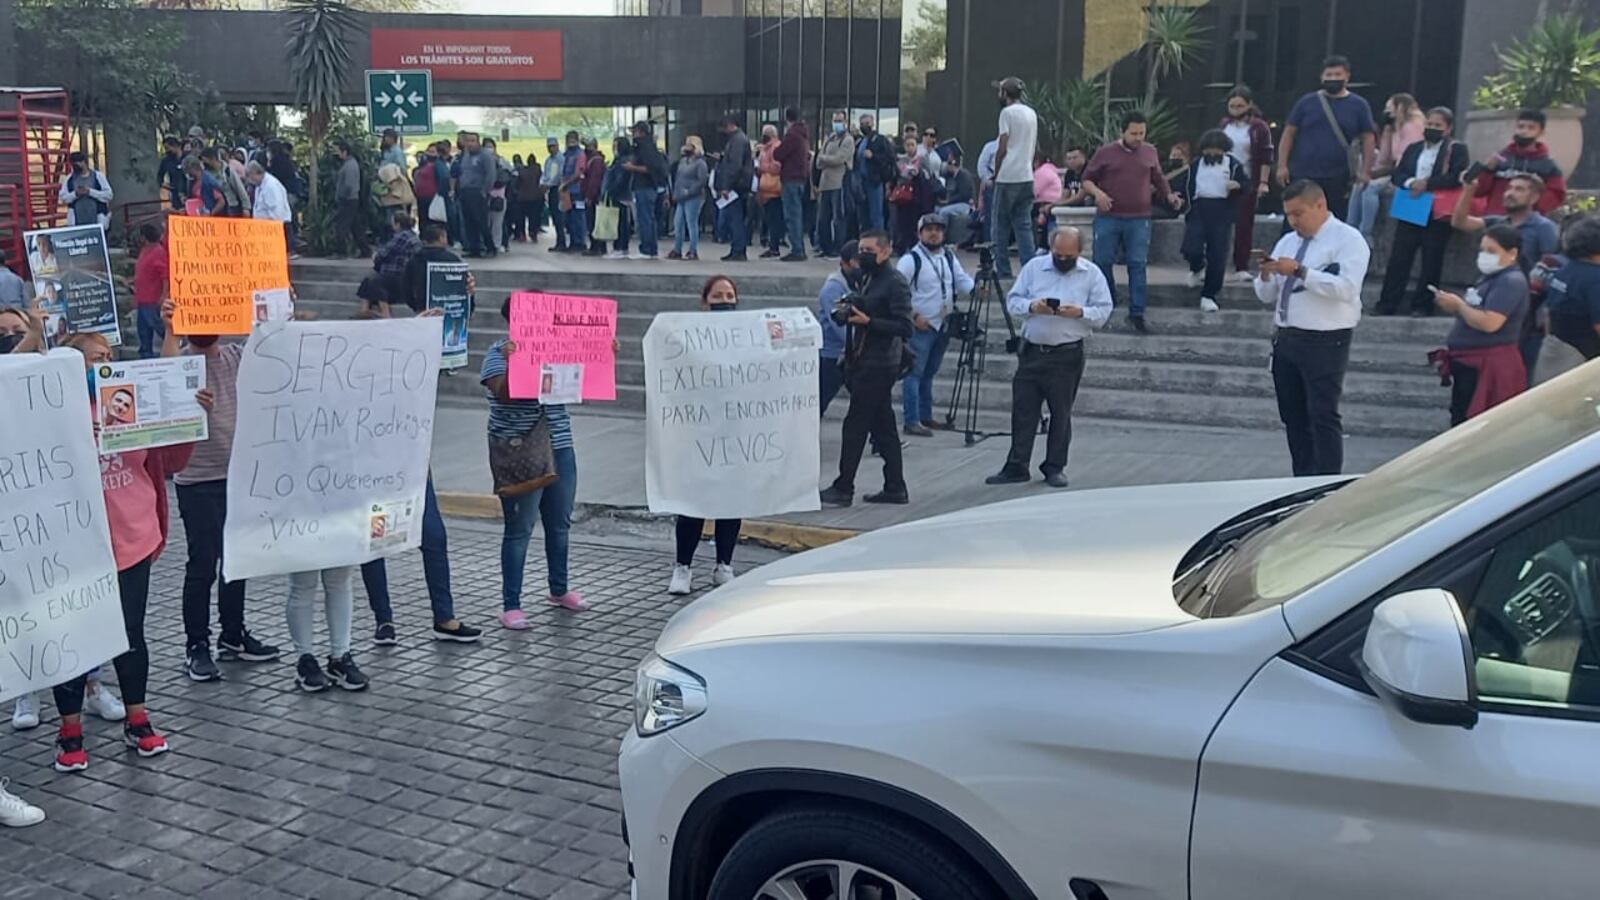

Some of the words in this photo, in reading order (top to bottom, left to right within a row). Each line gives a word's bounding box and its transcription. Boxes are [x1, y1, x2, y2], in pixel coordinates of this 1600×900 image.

[400, 56, 418, 64] LOS
[420, 54, 463, 64] TRÁMITES
[464, 56, 483, 64] SON
[485, 56, 534, 64] GRATUITOS
[423, 45, 433, 53] EN
[435, 45, 444, 53] EL
[174, 277, 184, 296] Y
[664, 326, 765, 360] SAMUEL
[252, 327, 428, 402] SERGIO
[659, 363, 770, 394] EXIGIMOS
[779, 359, 816, 378] AYUDA
[18, 372, 65, 411] TU
[251, 404, 348, 448] IVAN
[662, 405, 711, 428] PARA
[695, 431, 784, 468] VIVOS
[0, 445, 74, 495] RIAS
[306, 464, 406, 496] Queremos
[56, 499, 92, 534] TU
[26, 552, 71, 595] LOS
